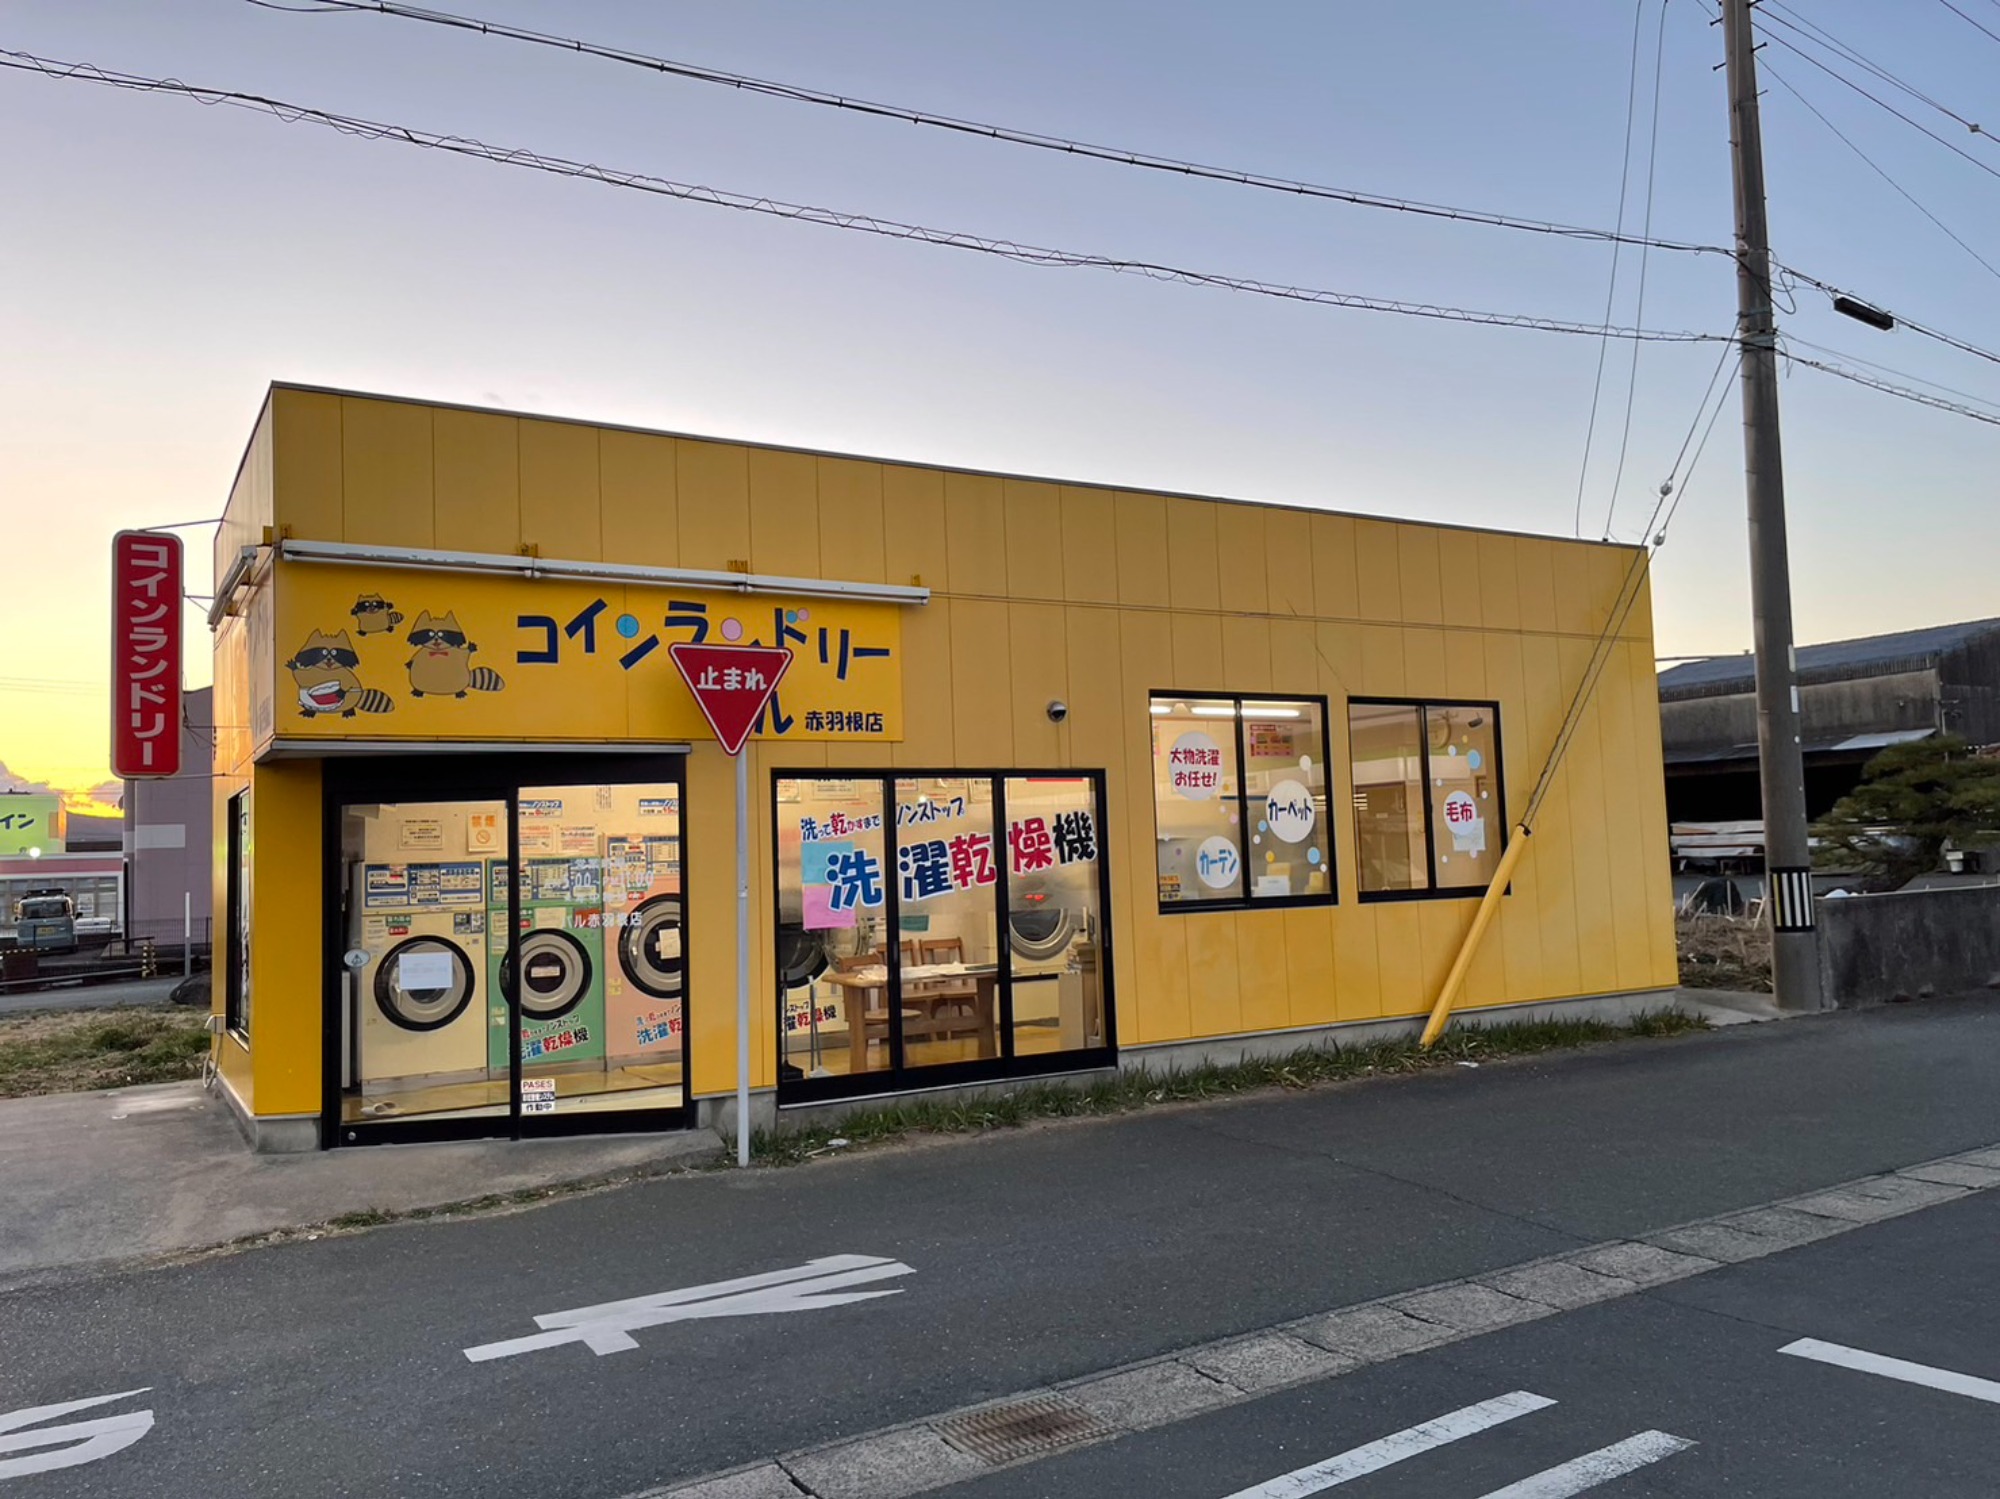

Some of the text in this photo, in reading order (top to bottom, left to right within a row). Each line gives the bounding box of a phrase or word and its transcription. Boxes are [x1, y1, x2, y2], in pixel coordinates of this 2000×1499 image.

[129, 543, 169, 766] コインランドリー
[696, 666, 767, 692] 止まれ
[805, 711, 884, 733] 赤羽根店
[1170, 748, 1220, 766] 大物洗濯
[897, 796, 964, 825] ノンストップ
[1268, 797, 1313, 822] カーペット
[1446, 802, 1474, 823] 毛布
[826, 811, 1097, 910] 洗濯乾燥機
[1200, 850, 1238, 876] カーテン
[522, 1080, 553, 1089] PASES
